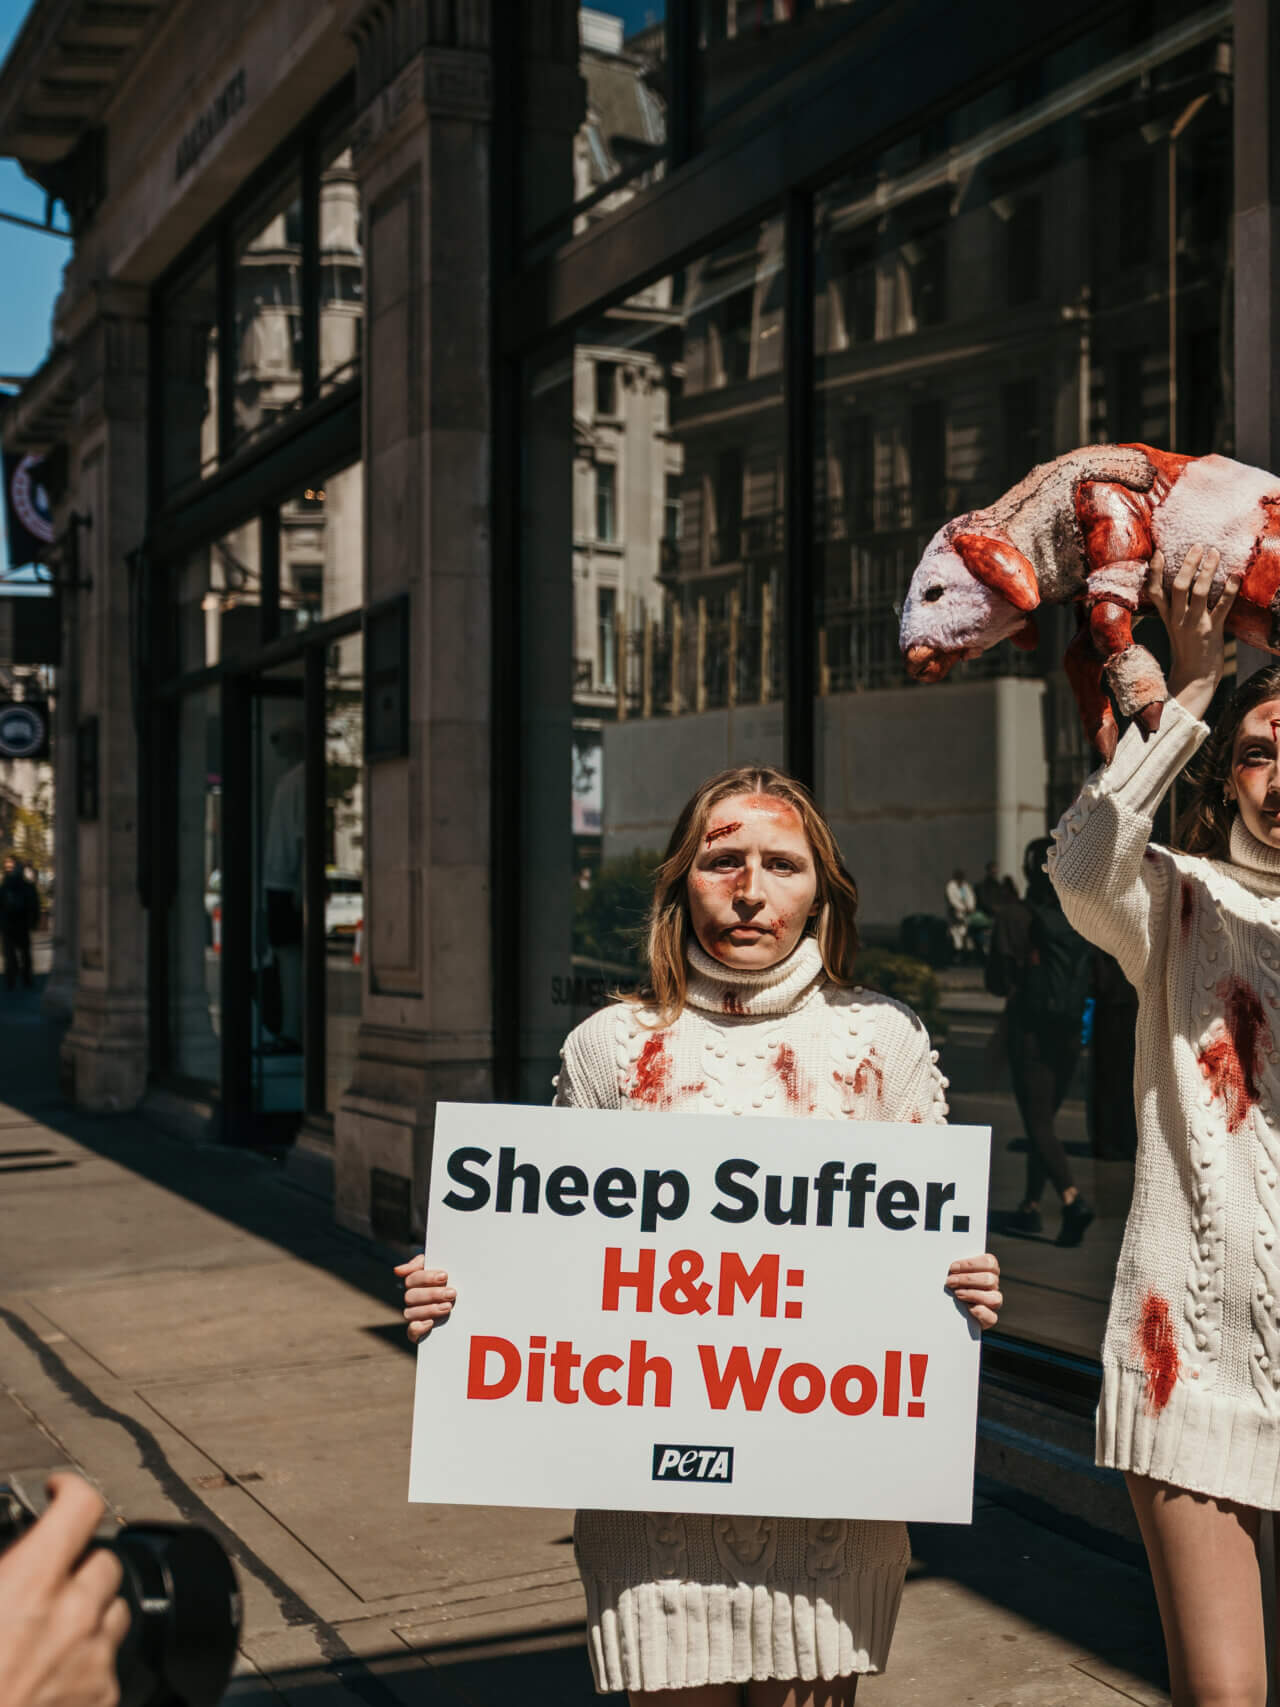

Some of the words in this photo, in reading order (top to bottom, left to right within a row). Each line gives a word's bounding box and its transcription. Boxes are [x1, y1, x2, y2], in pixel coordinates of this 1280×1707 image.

[442, 1147, 690, 1232] Sheep
[711, 1159, 970, 1232] Suffer.
[602, 1247, 804, 1318] H&M:
[467, 1336, 672, 1407] Ditch
[698, 1345, 928, 1417] Wool!
